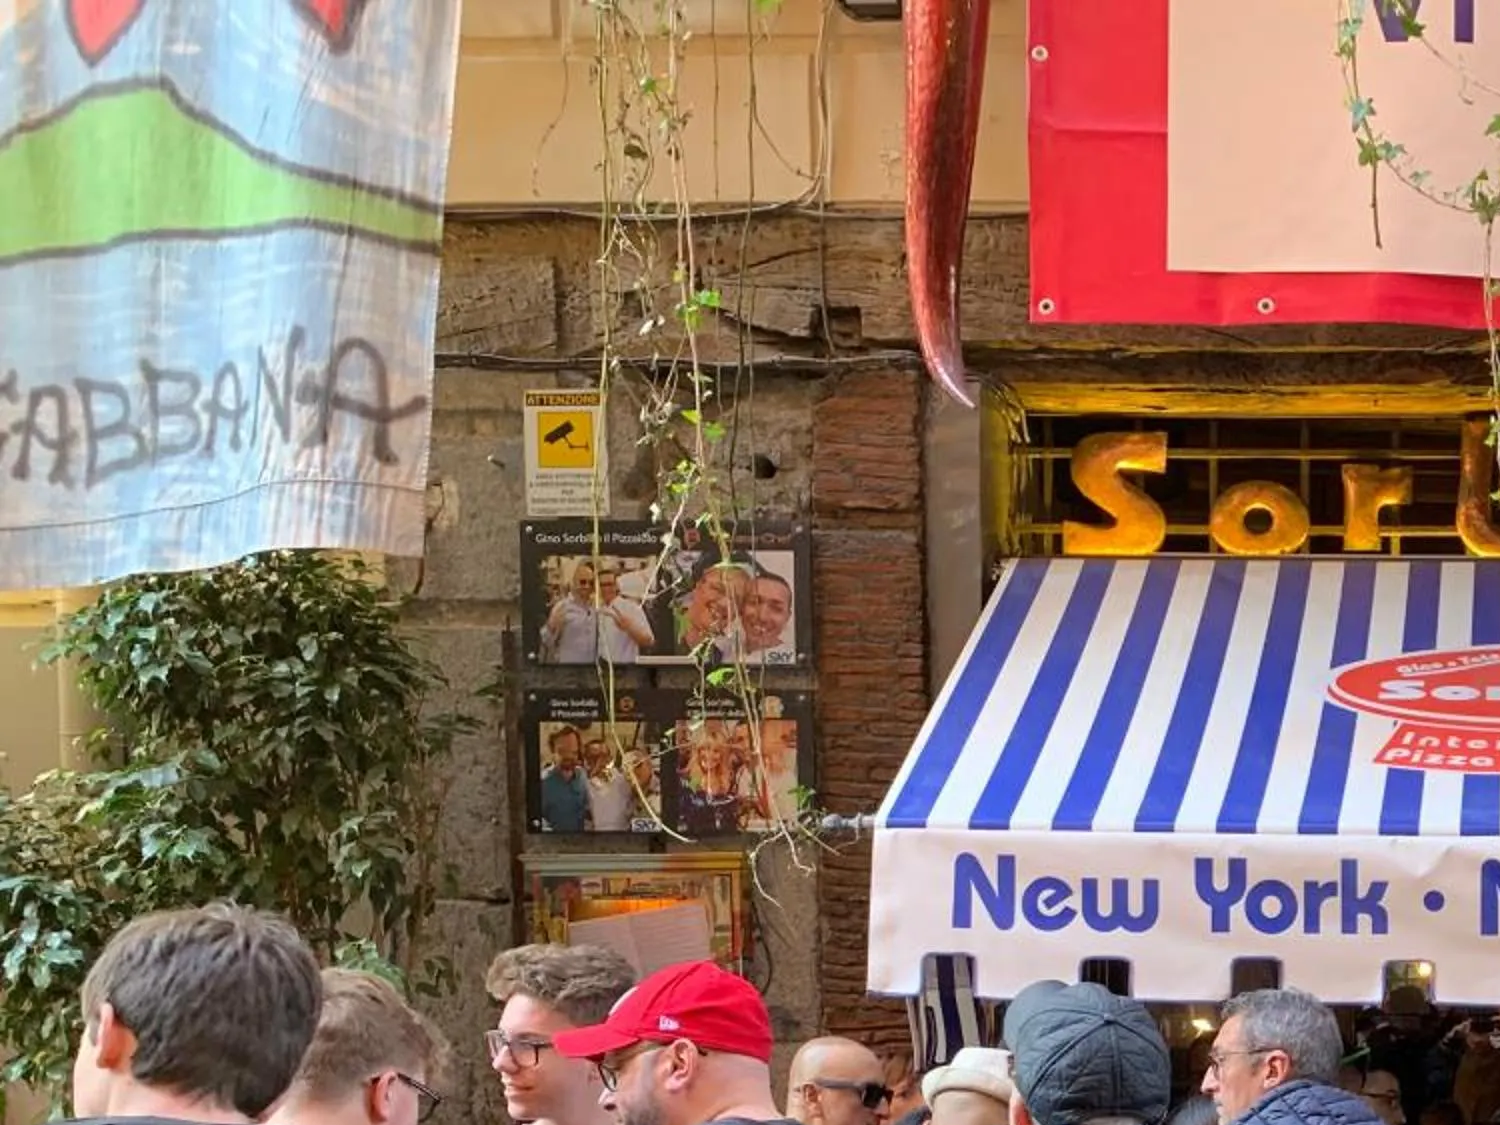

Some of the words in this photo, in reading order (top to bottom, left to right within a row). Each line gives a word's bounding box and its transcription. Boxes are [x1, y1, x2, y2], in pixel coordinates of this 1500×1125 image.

[0, 325, 428, 490] ABBANA
[1383, 748, 1495, 768] Pizza
[951, 852, 1159, 933] New
[1193, 857, 1389, 935] York
